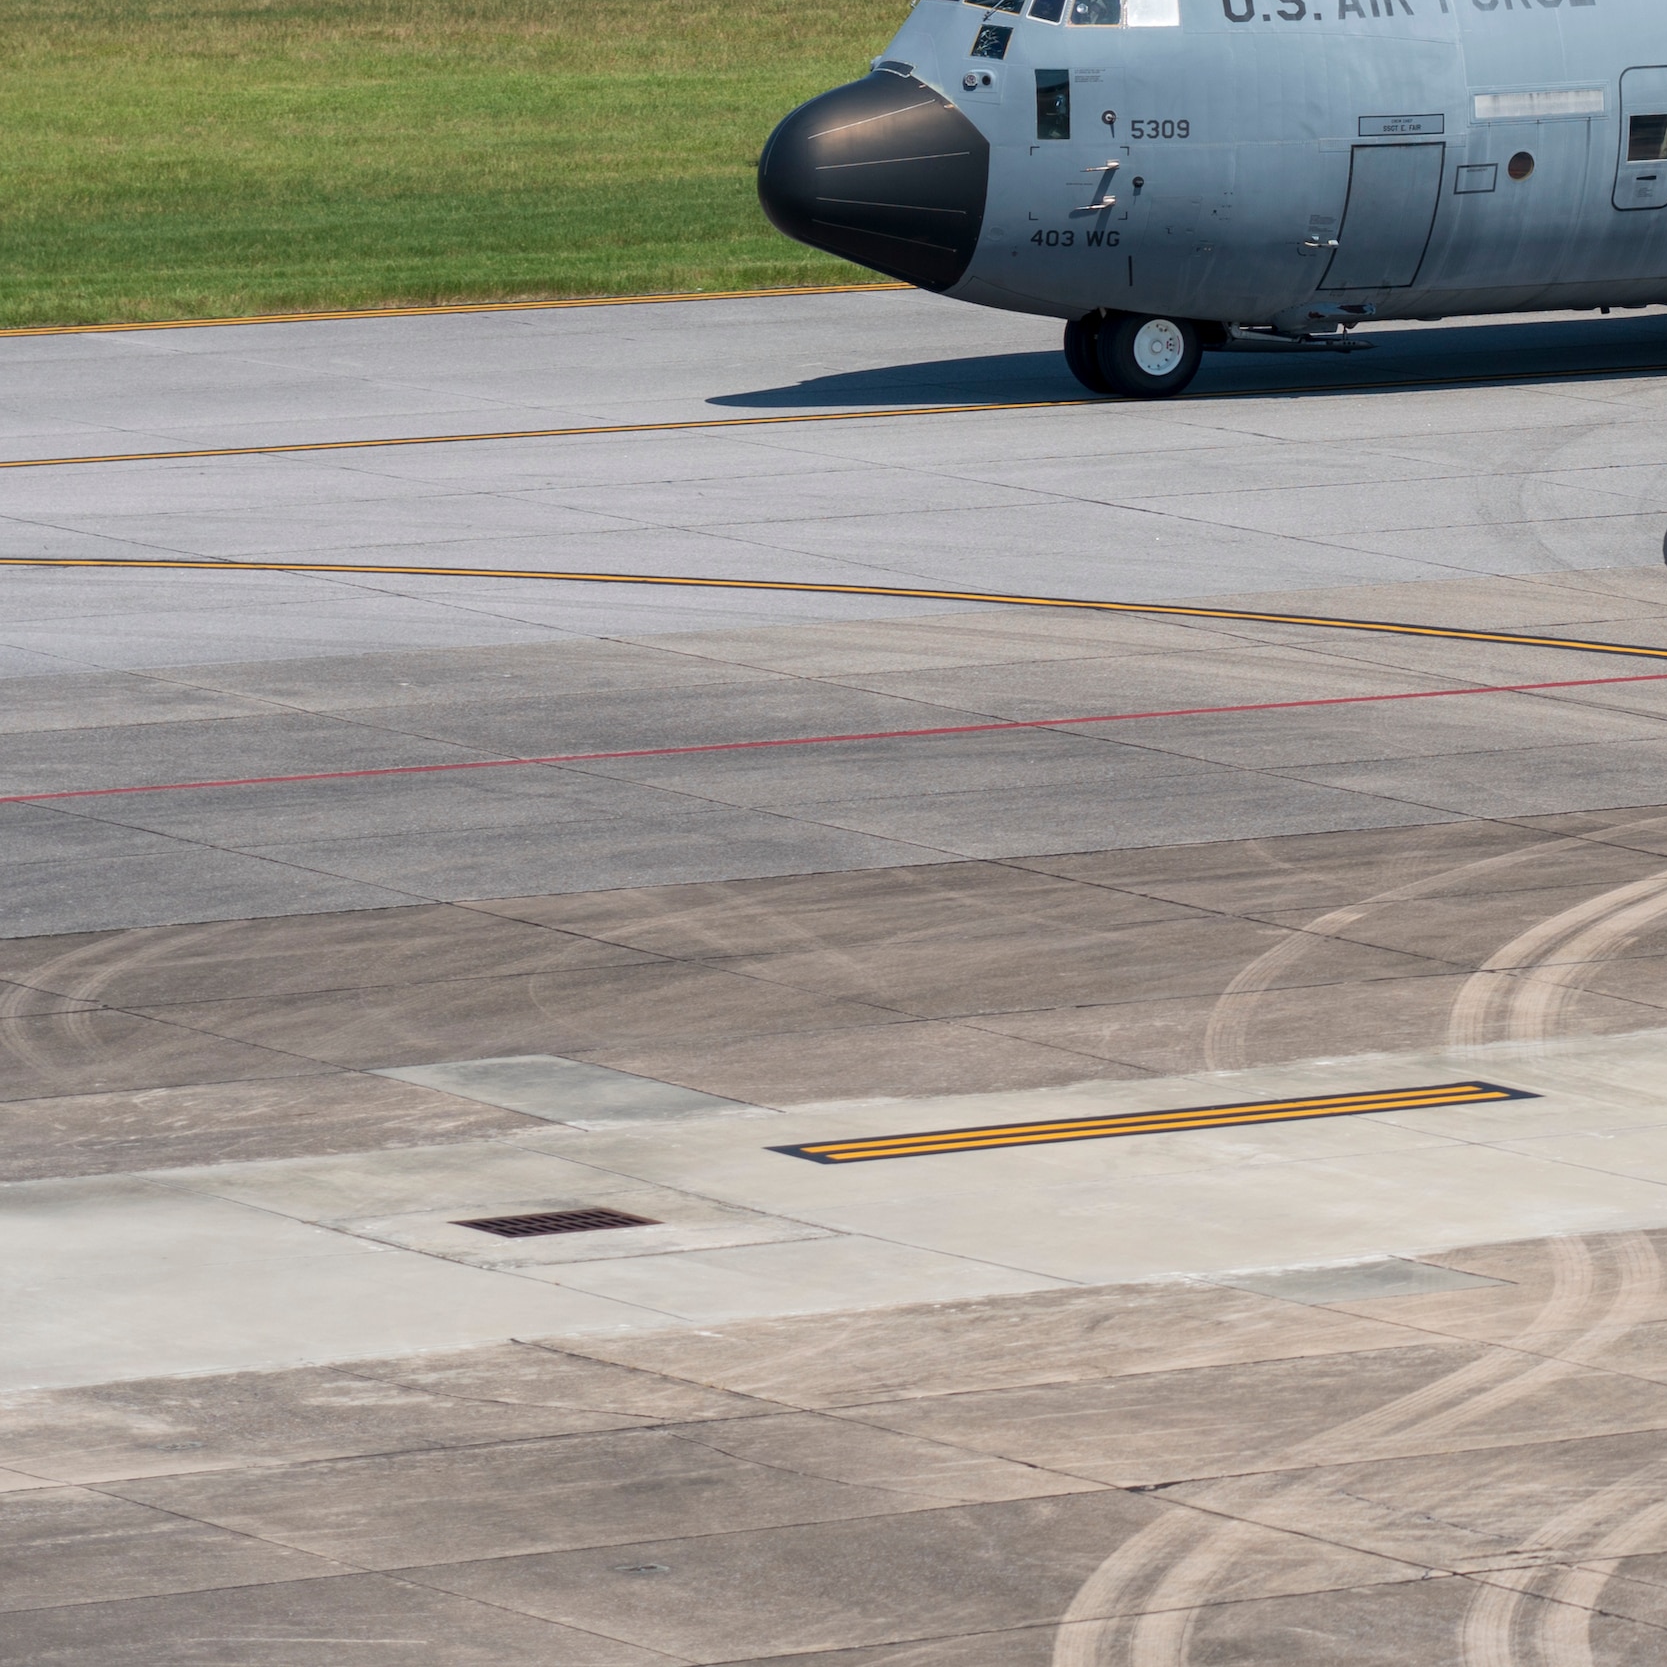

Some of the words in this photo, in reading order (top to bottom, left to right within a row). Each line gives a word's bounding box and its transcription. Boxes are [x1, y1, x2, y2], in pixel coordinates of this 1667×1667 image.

[1131, 120, 1190, 139] 5309
[1030, 230, 1074, 247] 403
[1086, 231, 1120, 247] WG
